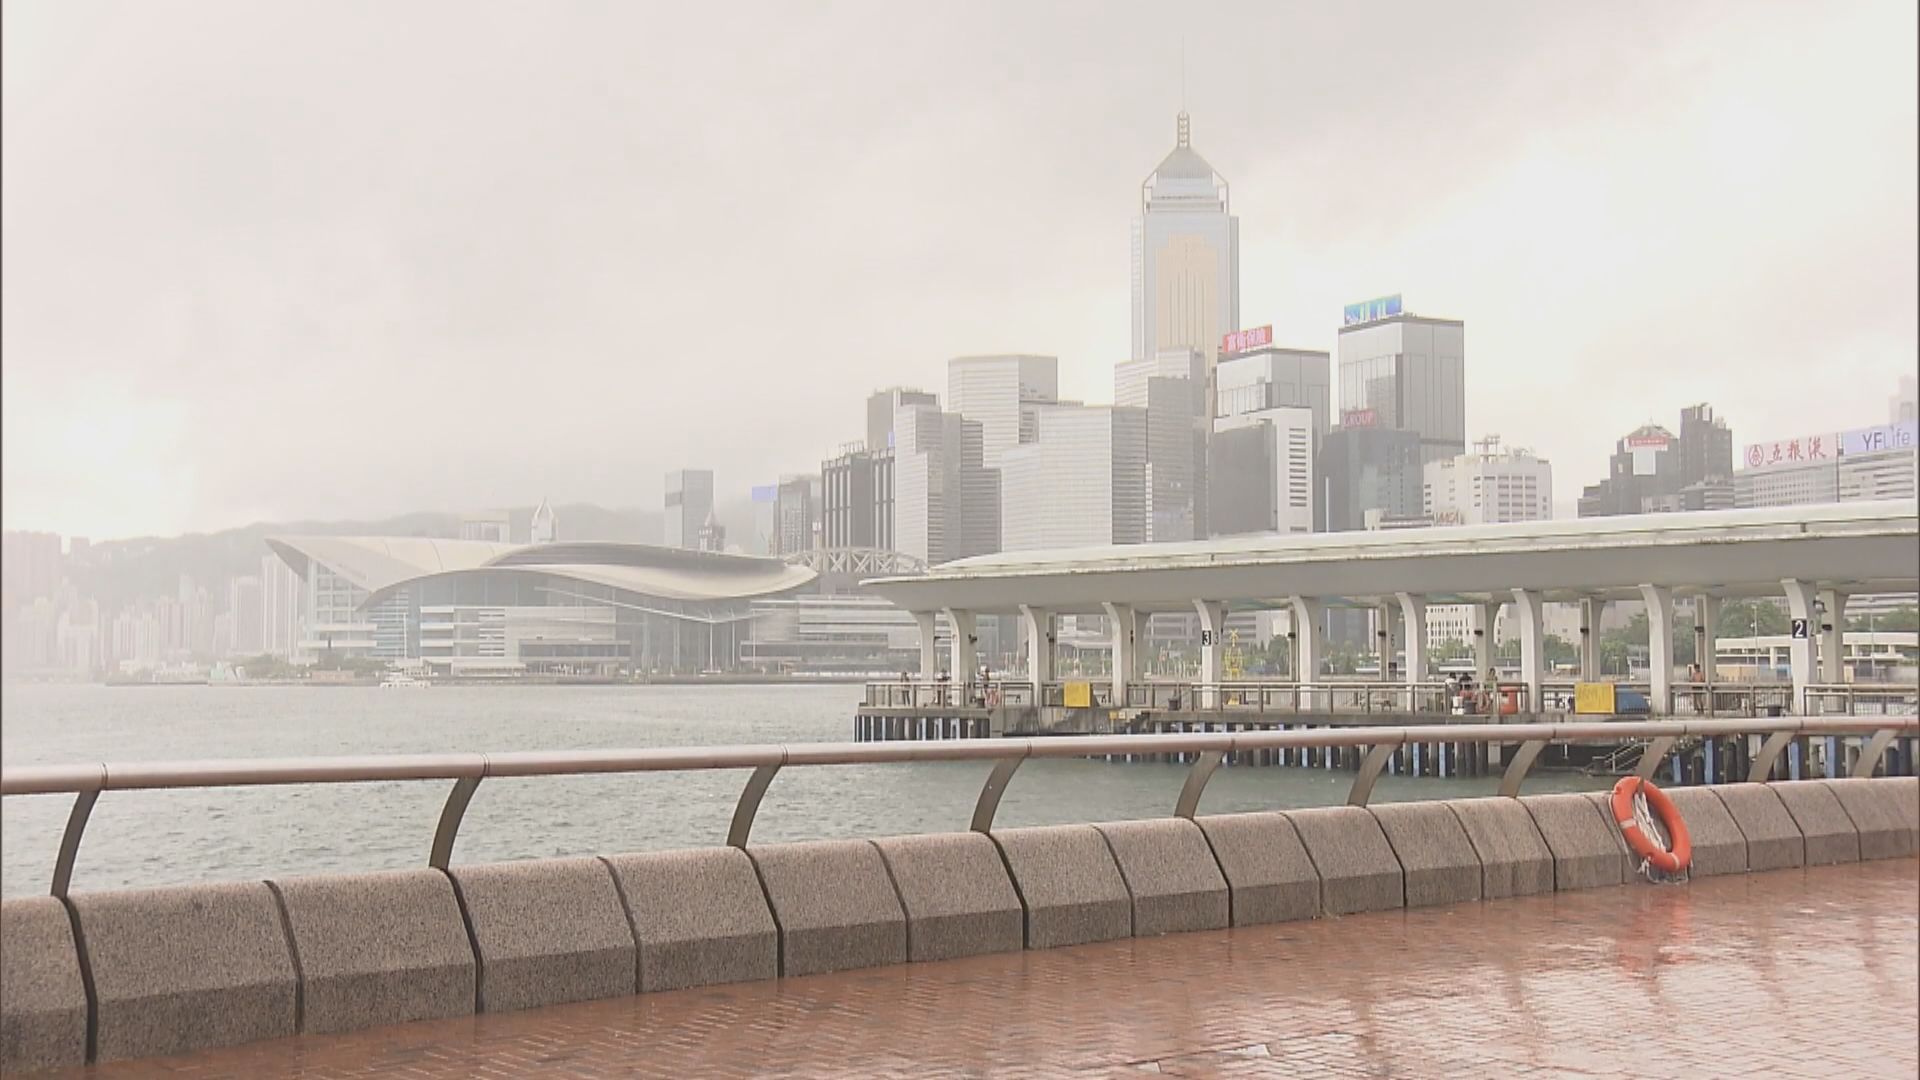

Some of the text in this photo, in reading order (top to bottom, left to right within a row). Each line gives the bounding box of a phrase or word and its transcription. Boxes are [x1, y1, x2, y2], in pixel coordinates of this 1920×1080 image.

[1862, 424, 1911, 451] YFLife
[1795, 620, 1804, 638] 2
[1203, 631, 1210, 646] 3
